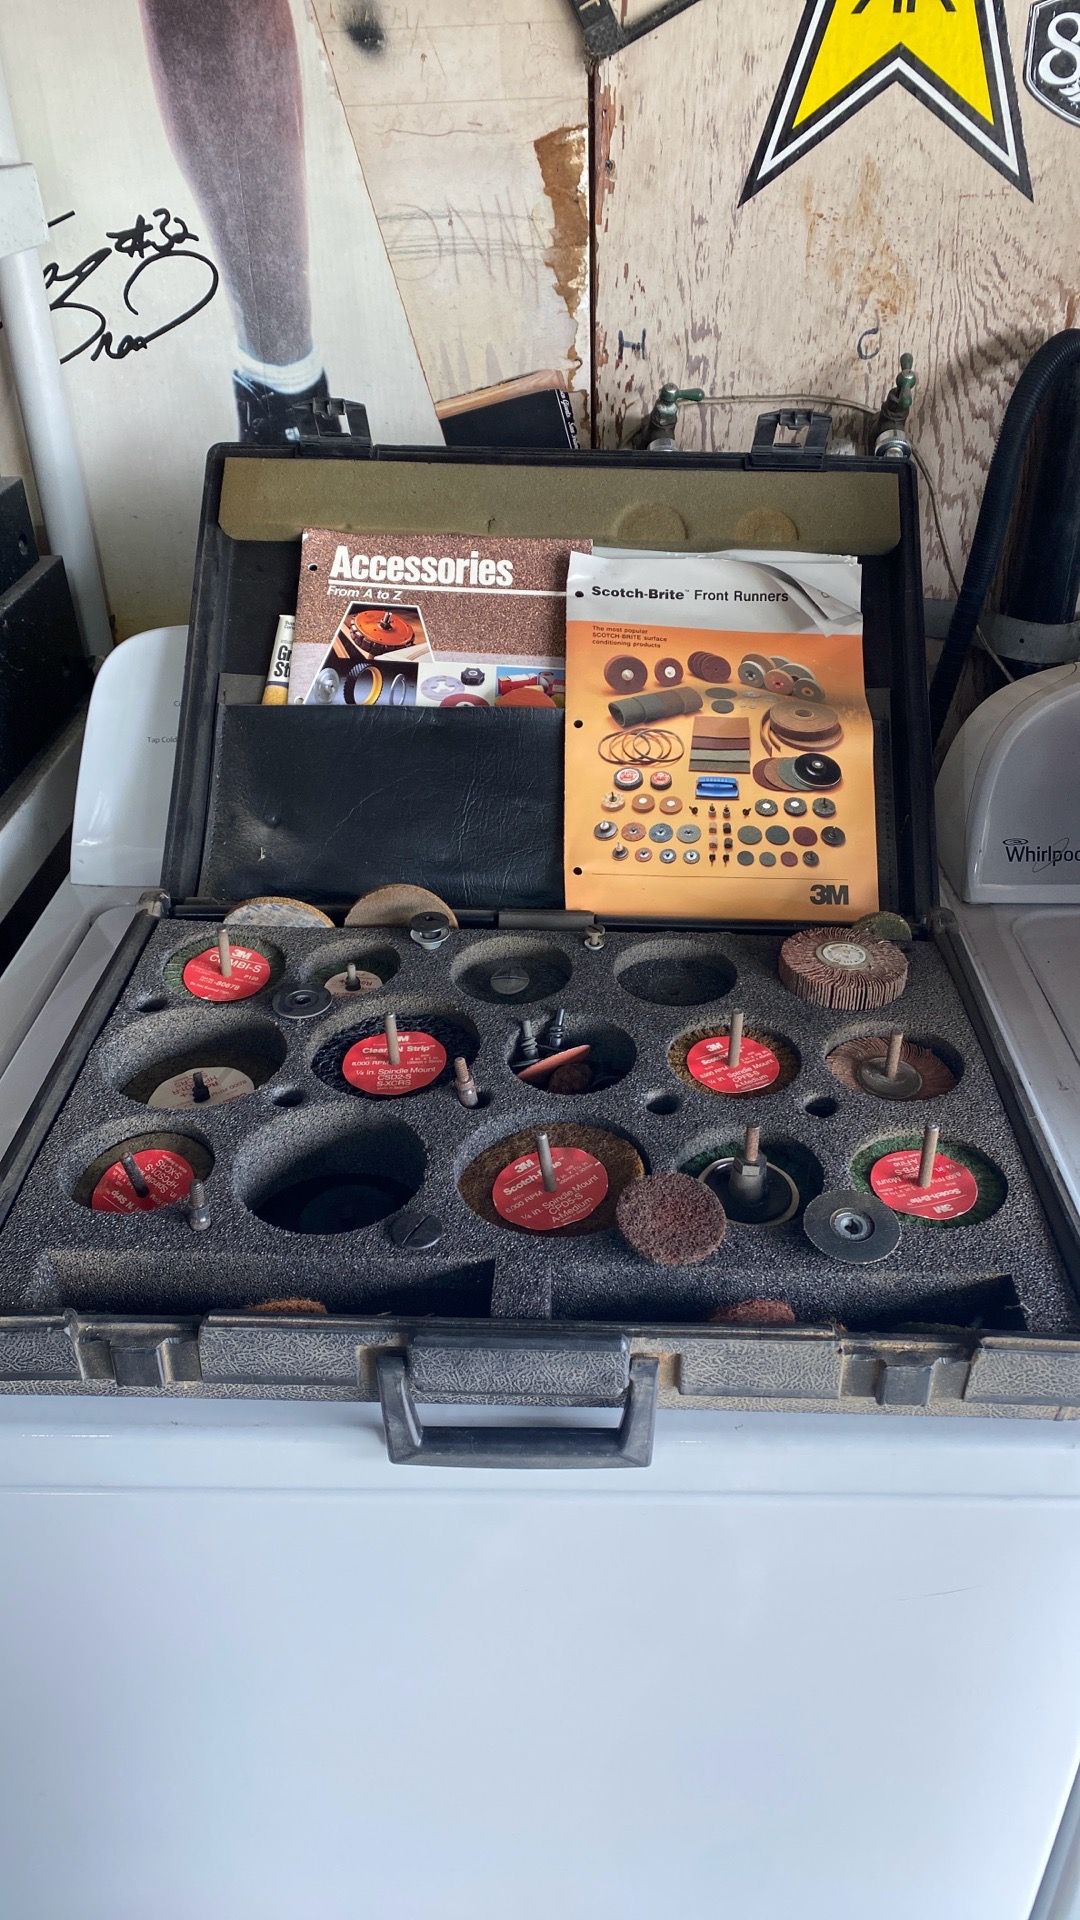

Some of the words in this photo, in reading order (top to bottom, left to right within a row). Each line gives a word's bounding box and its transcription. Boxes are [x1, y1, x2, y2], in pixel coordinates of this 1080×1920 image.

[329, 545, 514, 587] Accessories
[326, 585, 360, 599] From
[362, 589, 373, 599] A
[376, 590, 390, 600] to
[392, 591, 403, 600] Z
[694, 589, 729, 602] Front
[733, 590, 789, 602] Runners
[624, 627, 648, 635] popular
[592, 639, 631, 648] conditioning
[632, 641, 661, 649] products
[809, 884, 849, 905] 3M
[231, 949, 253, 960] 3M
[209, 953, 262, 973] CMBI-S
[706, 1042, 723, 1052] 3M
[377, 1068, 409, 1076] Spindle
[409, 1066, 436, 1074] Mount
[514, 1159, 535, 1173] 3M
[542, 1190, 574, 1211] Spindle
[571, 1174, 599, 1193] Mount
[932, 1203, 954, 1214] 3M
